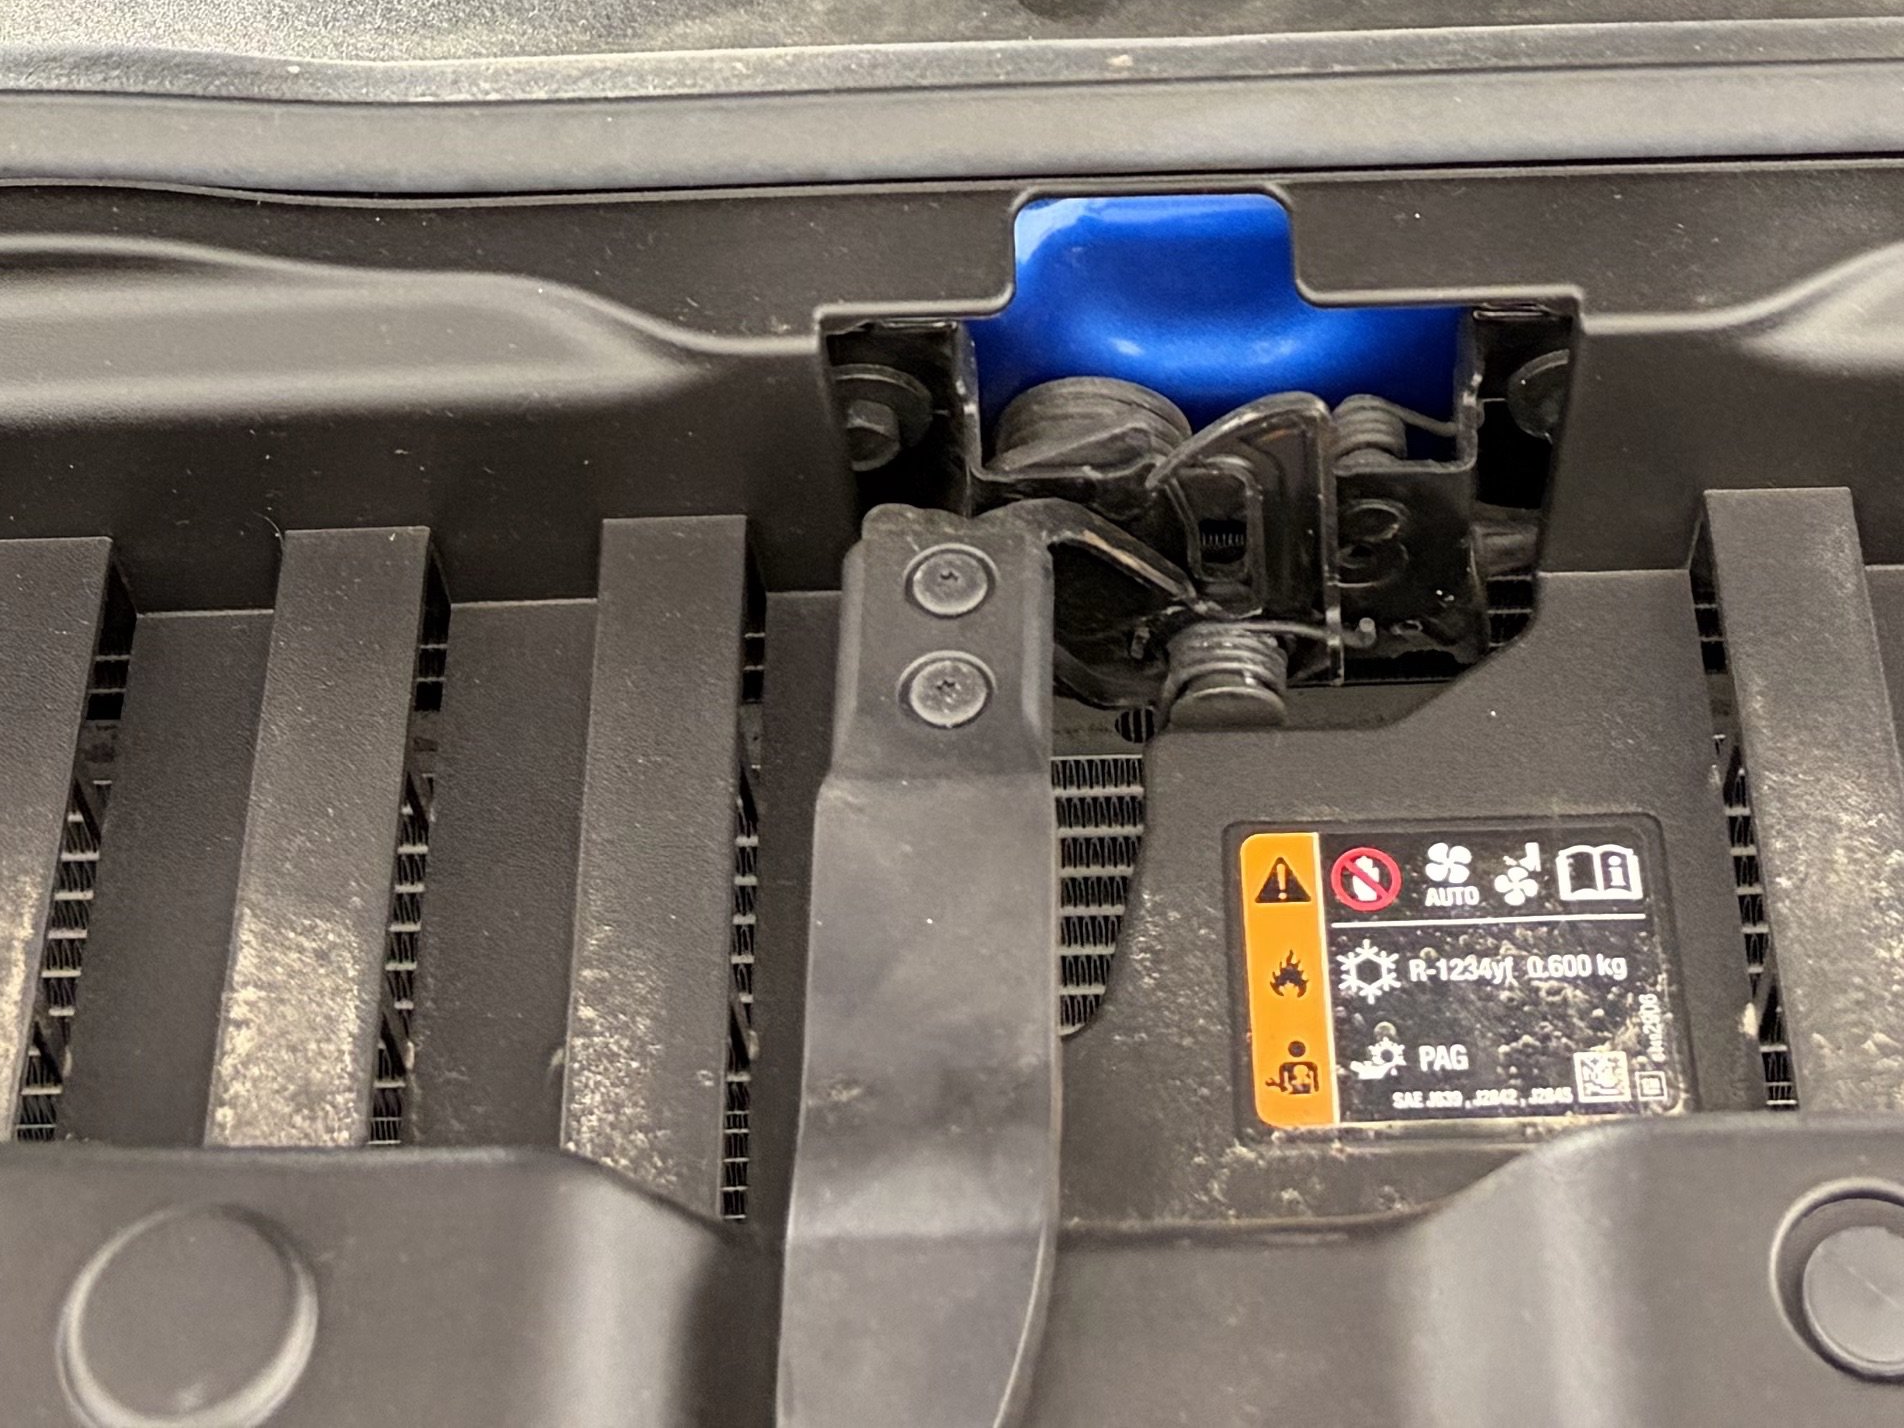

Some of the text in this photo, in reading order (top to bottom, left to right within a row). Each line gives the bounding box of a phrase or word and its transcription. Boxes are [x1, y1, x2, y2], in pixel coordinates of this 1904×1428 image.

[1425, 886, 1480, 907] AUTO
[1409, 953, 1628, 985] R-1234yf 0.600 kg
[1418, 1044, 1469, 1072] PAG
[1392, 1091, 1424, 1109] SAE
